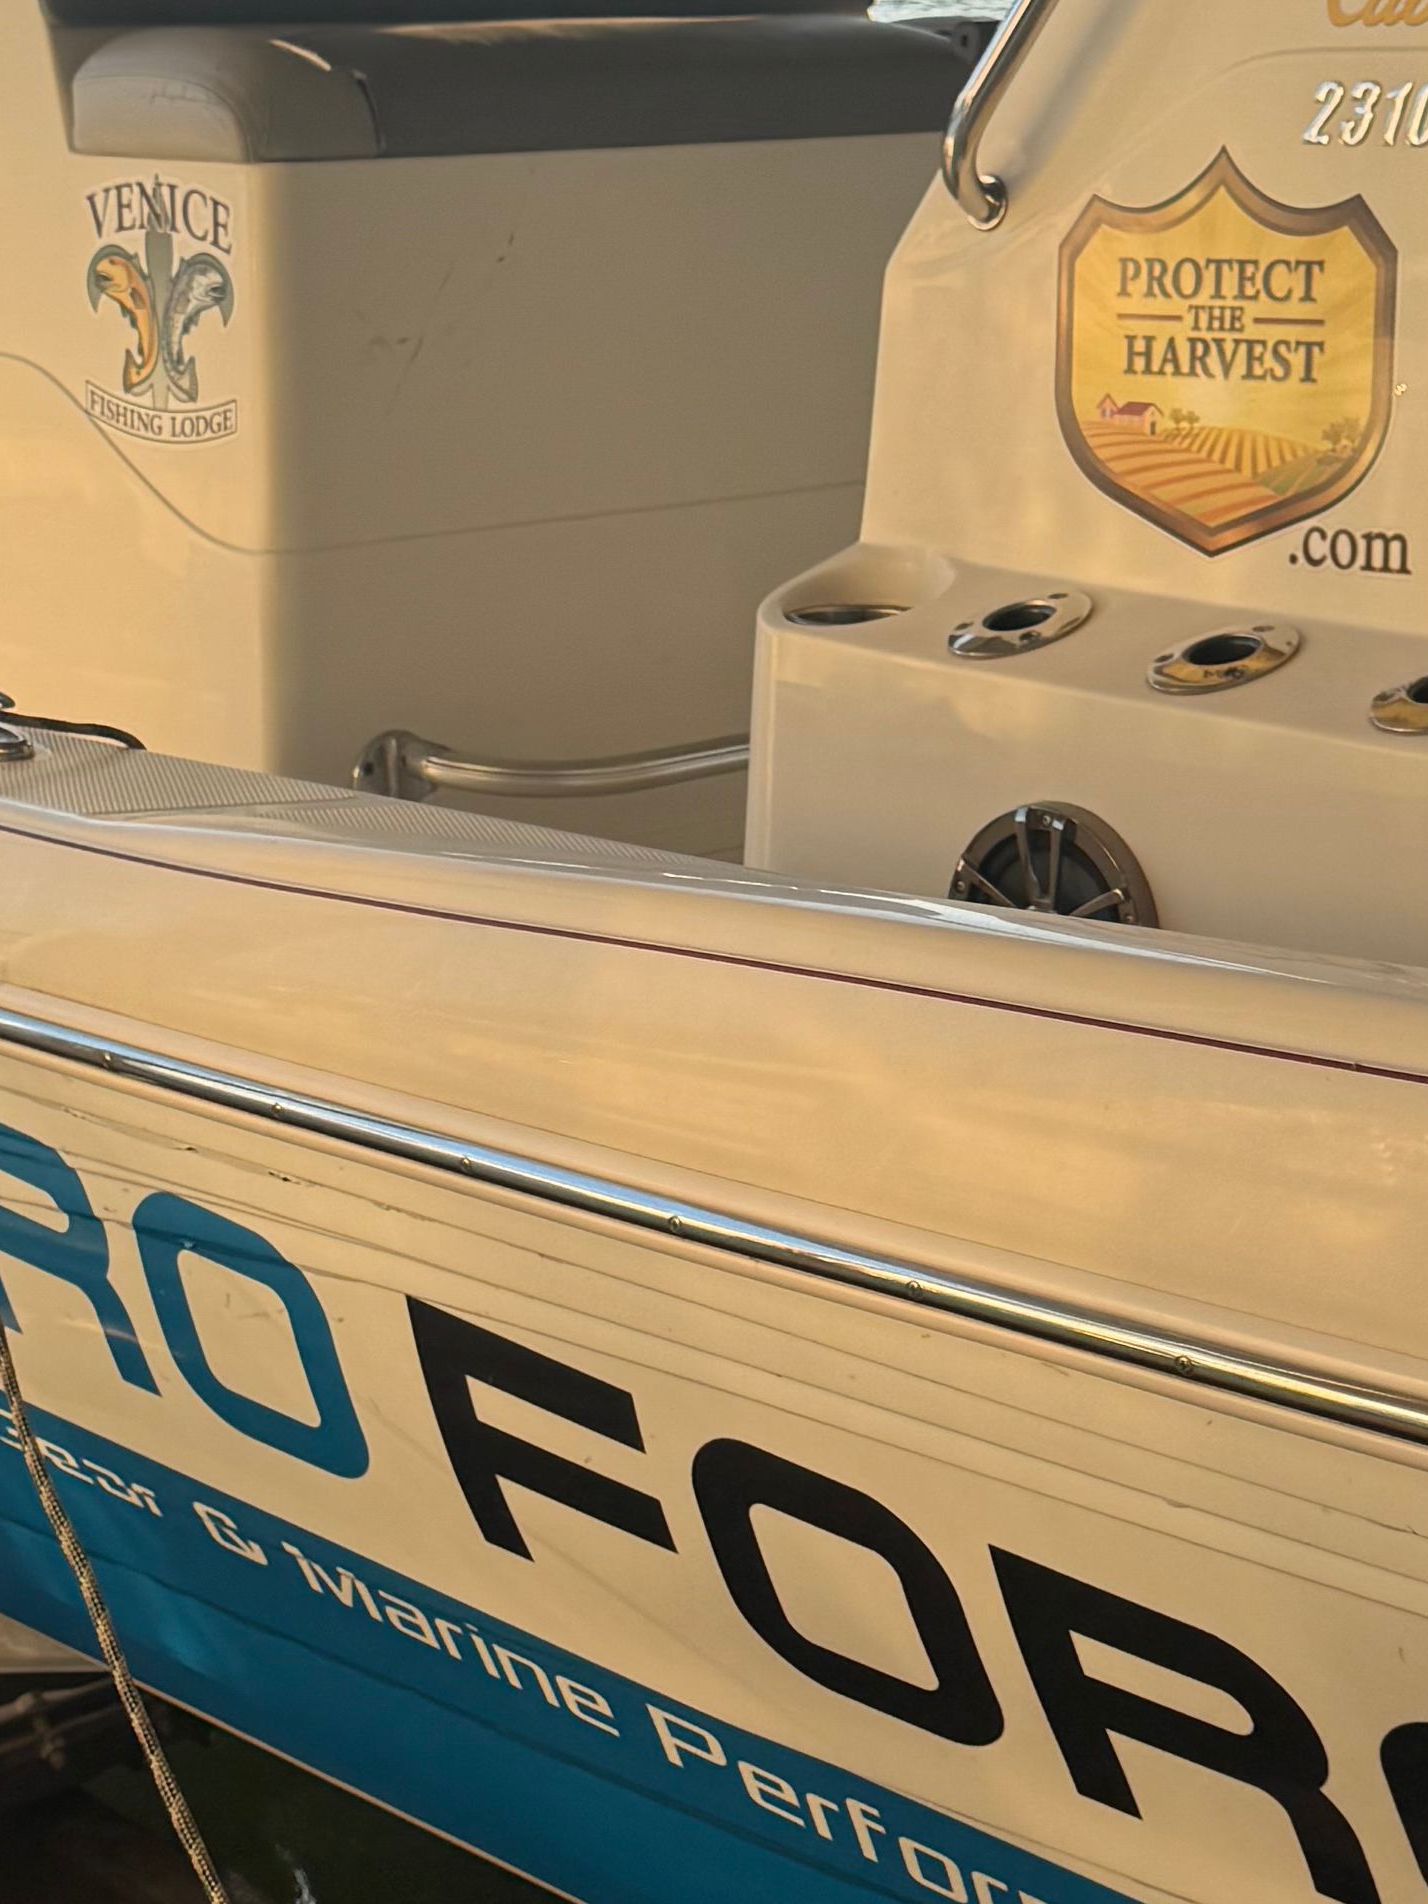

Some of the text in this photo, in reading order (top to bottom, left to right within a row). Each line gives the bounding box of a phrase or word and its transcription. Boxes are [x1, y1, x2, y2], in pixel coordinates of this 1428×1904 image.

[85, 181, 232, 255] VENICE
[1116, 256, 1325, 304] PROTECT
[1187, 305, 1245, 333] THE
[1122, 336, 1325, 384] HARVEST
[89, 390, 233, 439] FISHING LODGE
[1288, 525, 1412, 575] .com
[280, 1541, 620, 1738] Marine
